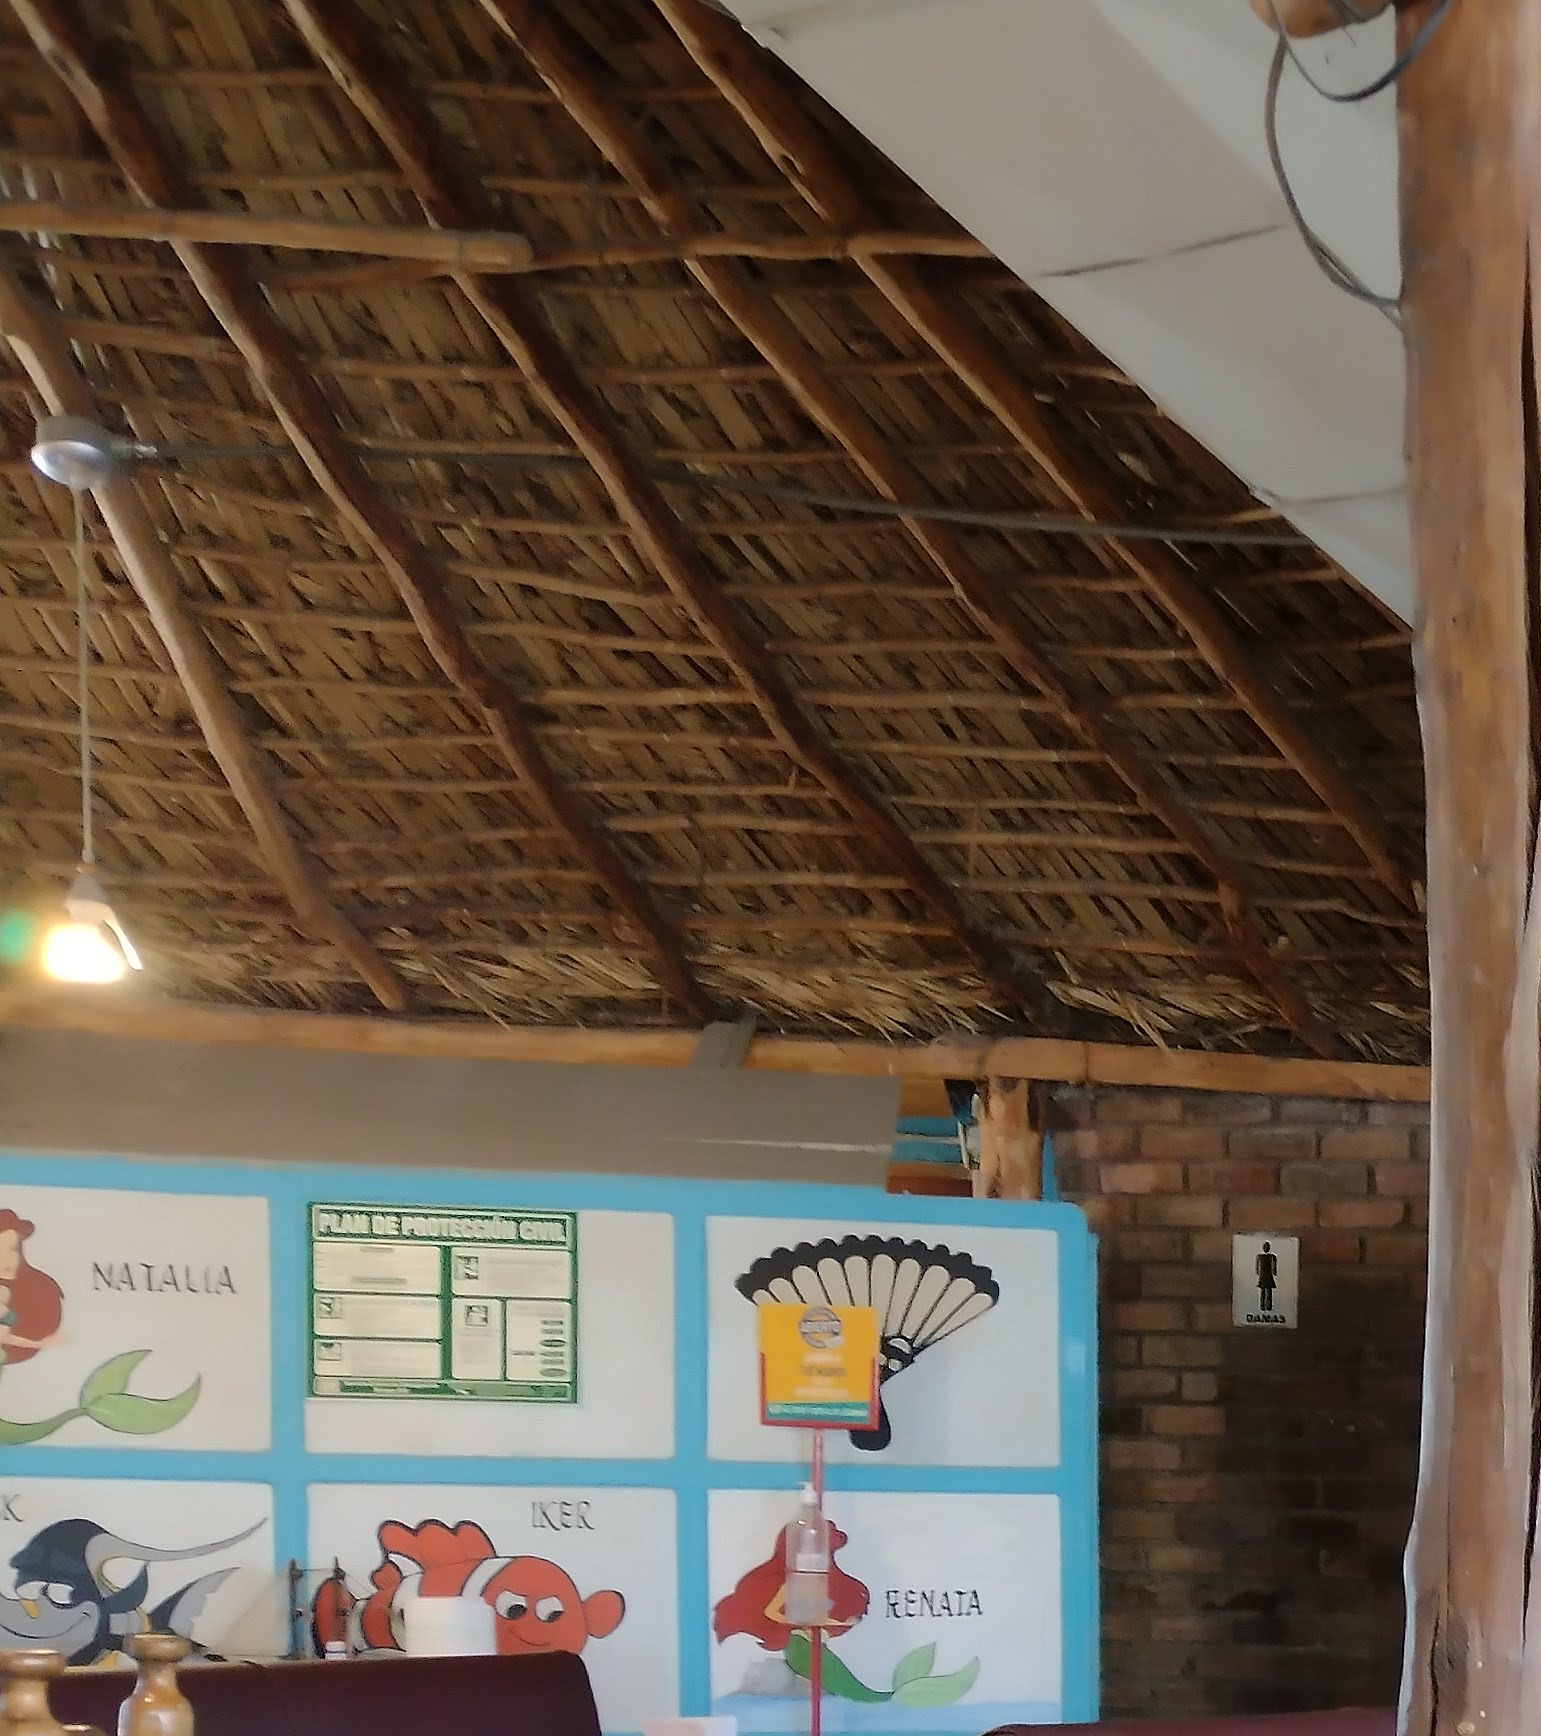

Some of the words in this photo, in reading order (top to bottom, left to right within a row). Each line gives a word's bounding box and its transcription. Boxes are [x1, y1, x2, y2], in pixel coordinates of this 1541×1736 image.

[318, 1212, 370, 1235] PLAN
[372, 1213, 400, 1236] DE
[92, 1261, 238, 1295] NATALIA
[1246, 1313, 1286, 1324] DAMAS
[531, 1500, 595, 1532] IKER
[885, 1589, 983, 1619] RENATA
